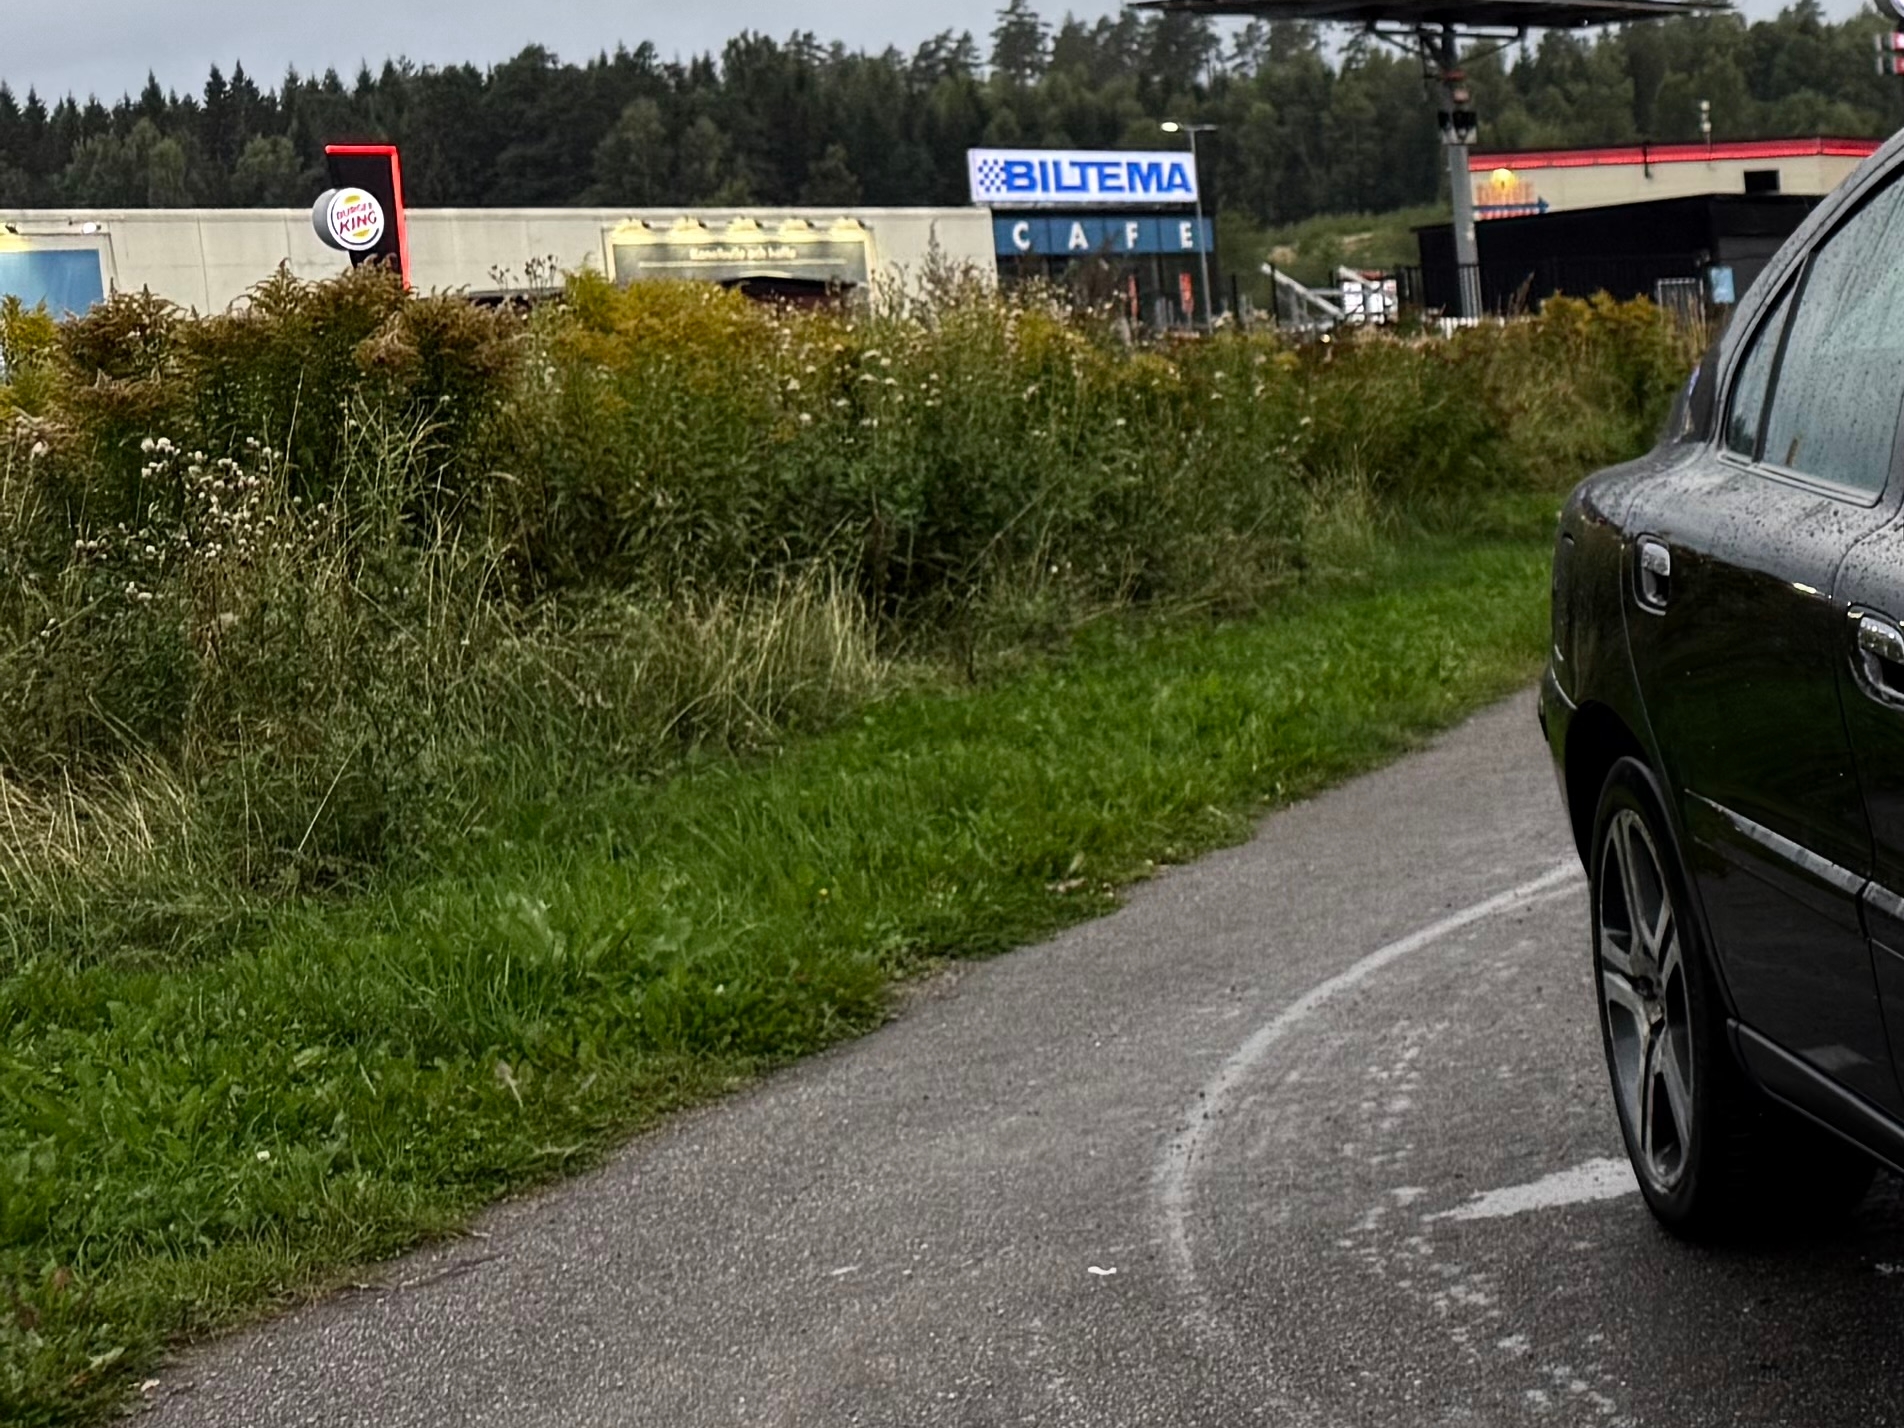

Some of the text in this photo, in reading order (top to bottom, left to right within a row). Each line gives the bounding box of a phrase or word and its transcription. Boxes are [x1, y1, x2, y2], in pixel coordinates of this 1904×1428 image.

[1003, 159, 1193, 194] BILTEMA
[339, 211, 377, 234] KING
[1011, 220, 1194, 252] CAFE
